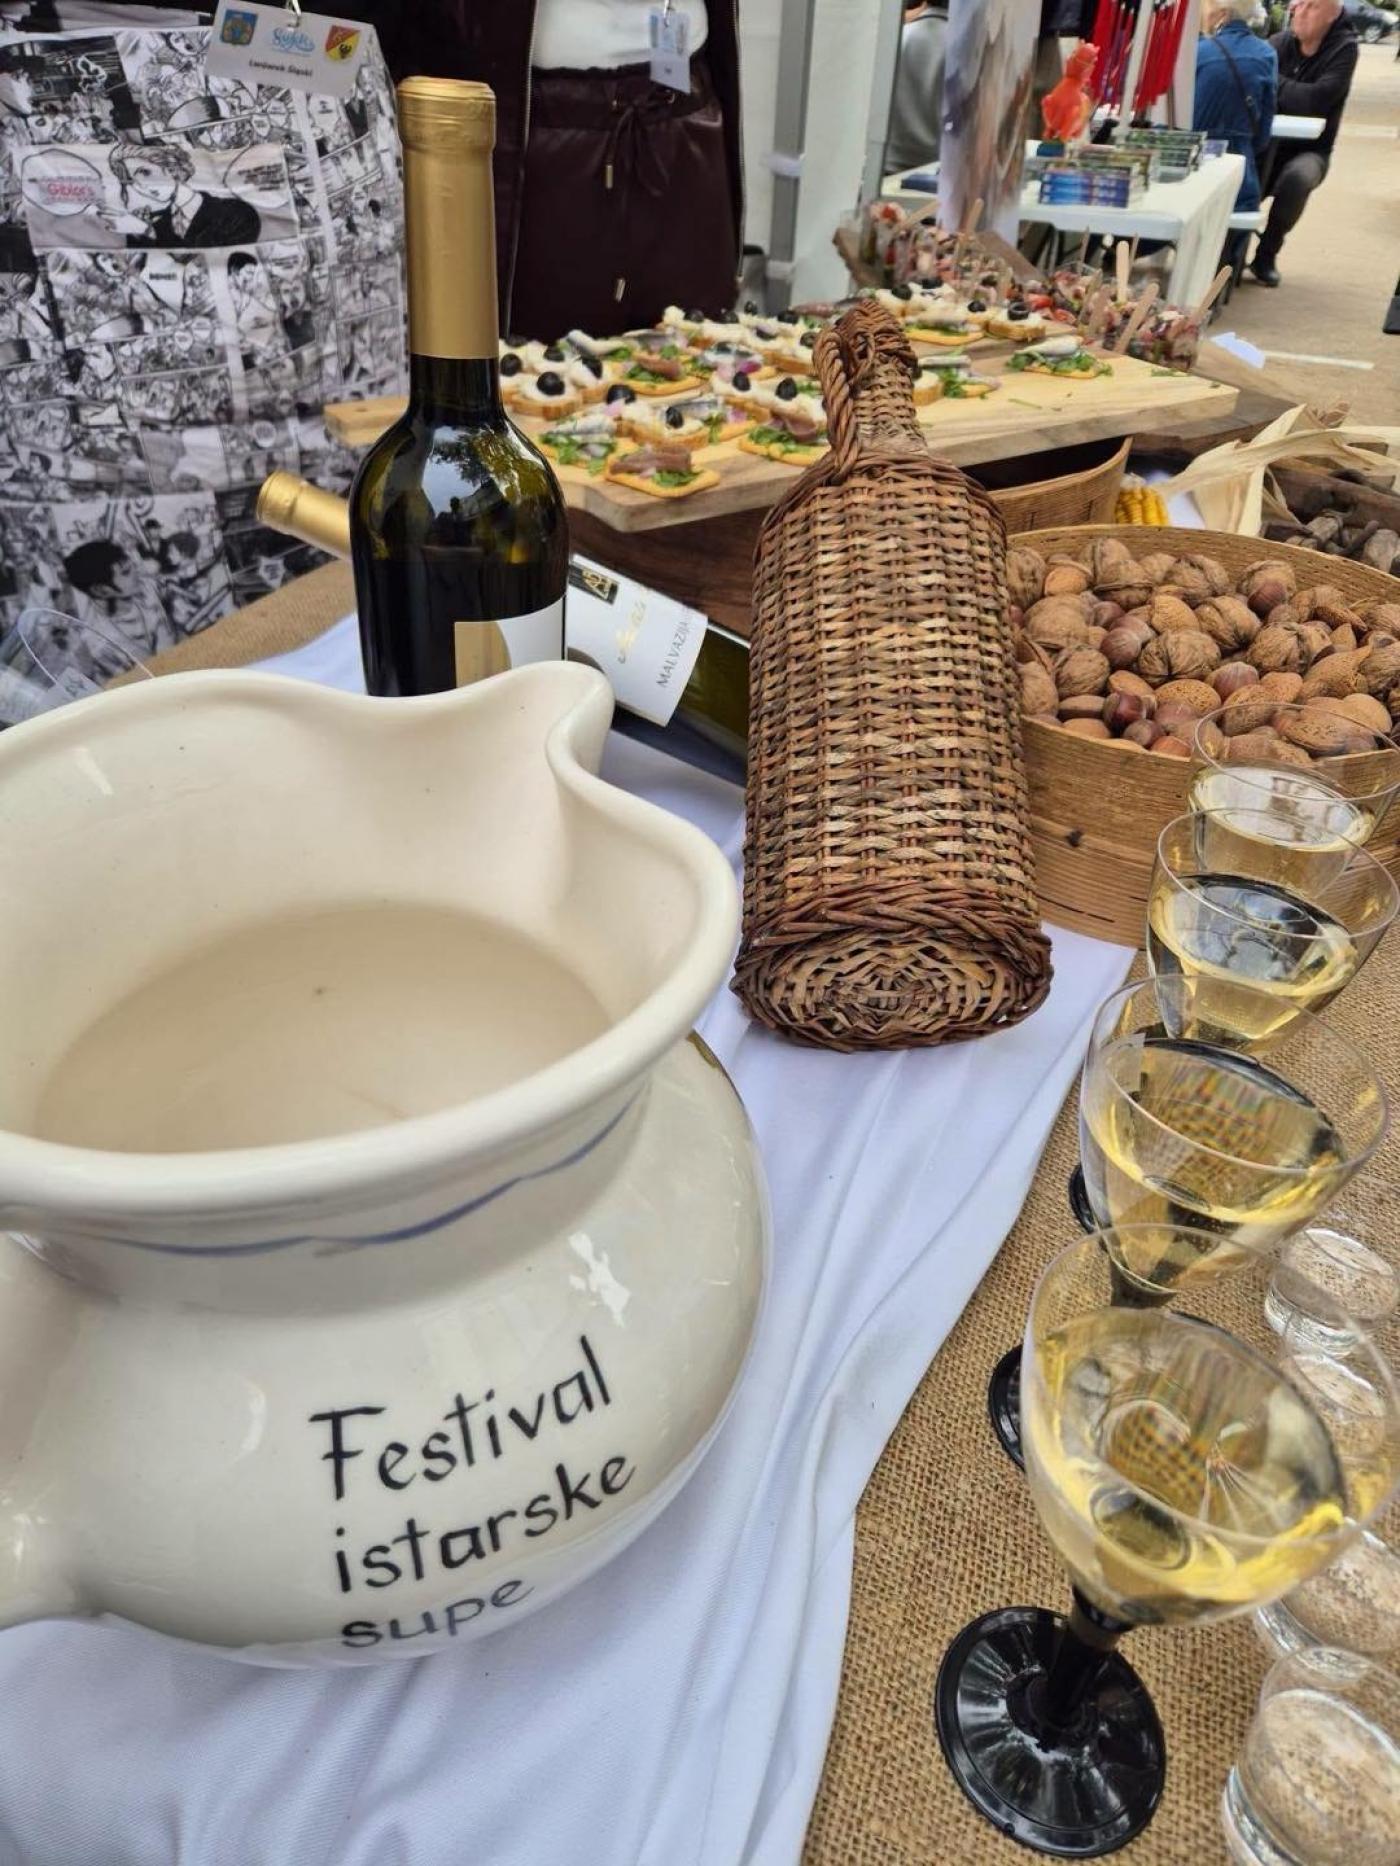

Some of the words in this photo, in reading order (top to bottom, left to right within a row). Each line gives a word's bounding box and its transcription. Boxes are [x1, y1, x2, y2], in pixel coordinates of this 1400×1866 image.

[308, 1334, 611, 1500] Festival
[336, 1456, 636, 1593] istarske
[341, 1580, 535, 1648] supe
